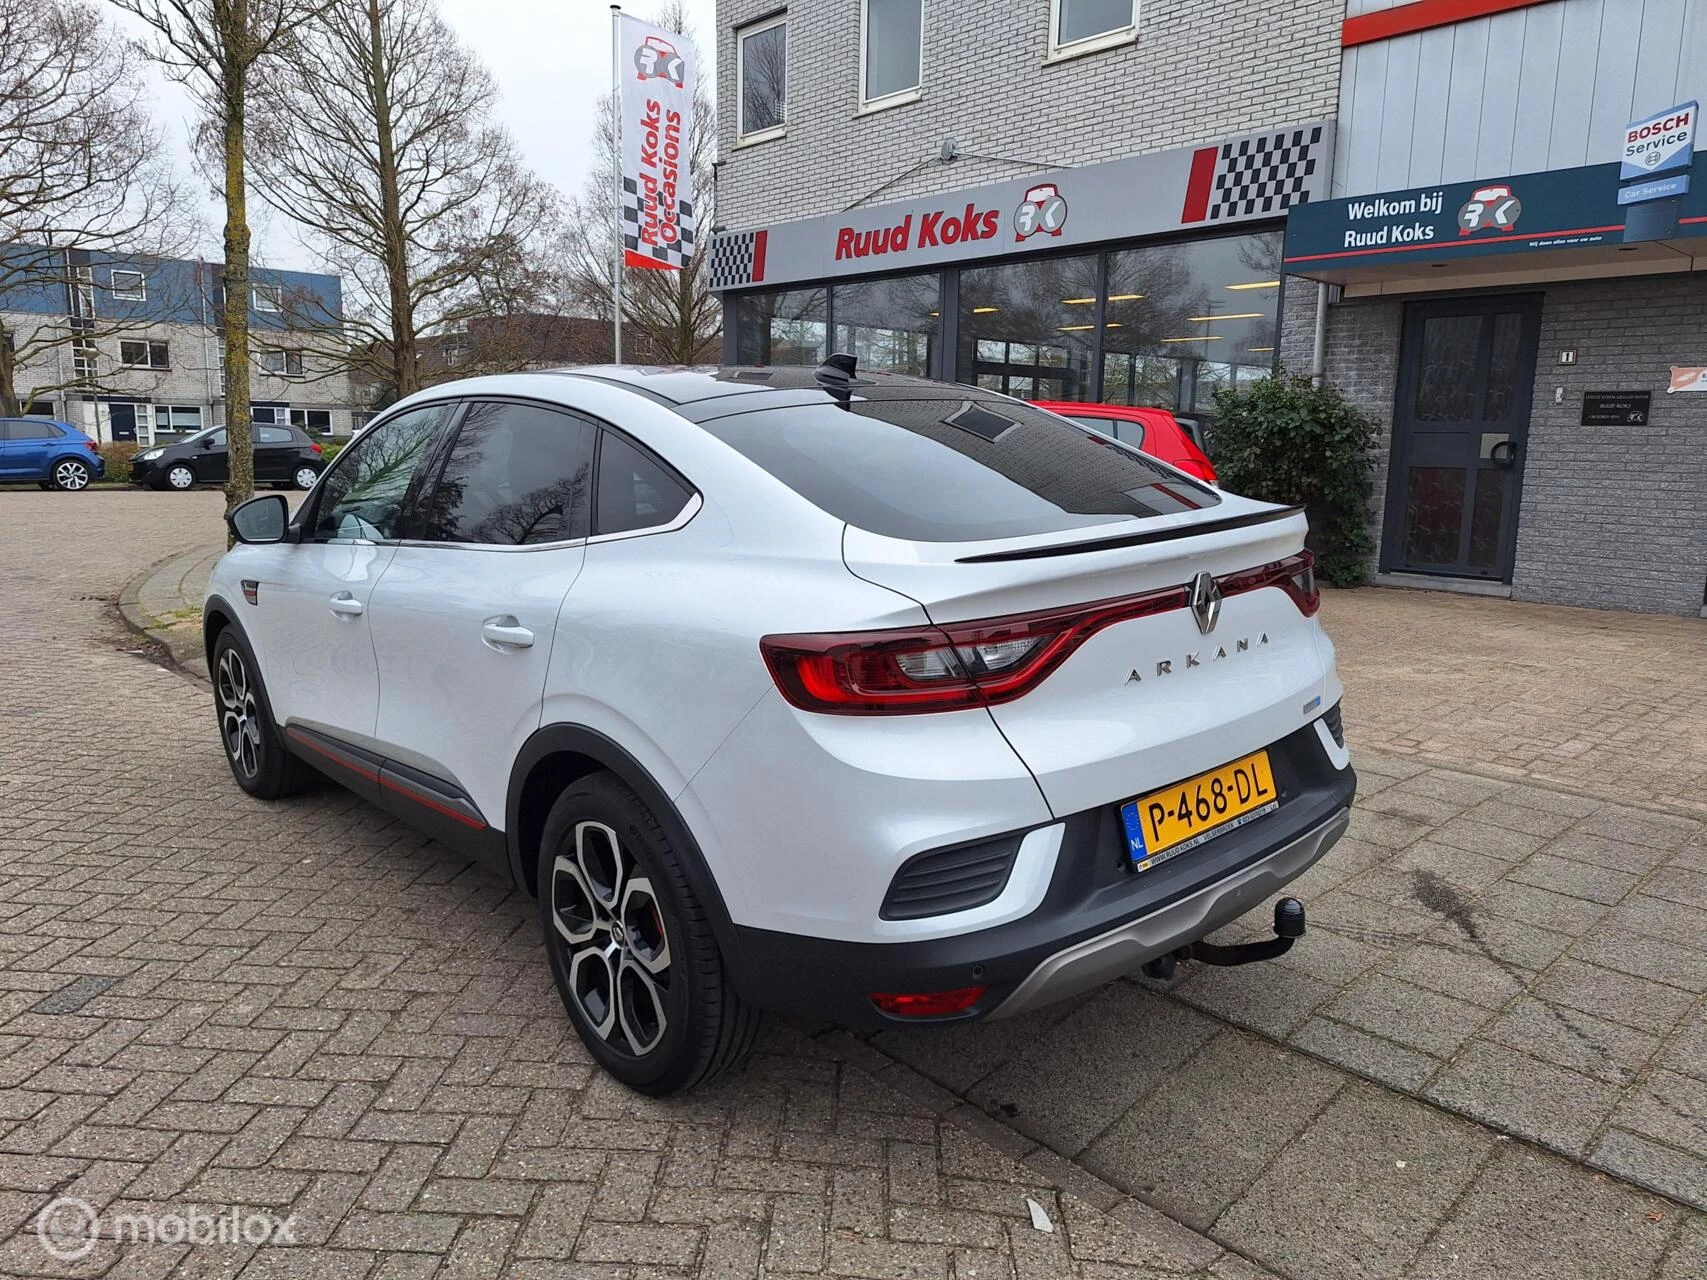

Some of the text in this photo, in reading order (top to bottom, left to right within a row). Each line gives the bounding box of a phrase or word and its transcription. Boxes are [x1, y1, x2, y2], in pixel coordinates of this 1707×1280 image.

[1625, 129, 1688, 157] Service
[1626, 112, 1690, 144] BOSCH
[639, 99, 661, 247] Ruud Koks
[658, 109, 682, 245] Occasions
[1347, 191, 1443, 220] Welkom bij
[1623, 181, 1677, 200] Car Service
[835, 203, 1000, 260] Ruud Koks
[1342, 222, 1435, 248] Ruud Koks
[1124, 631, 1270, 685] ARKANA
[1148, 764, 1268, 842] P-468-DL
[1130, 838, 1144, 851] NL
